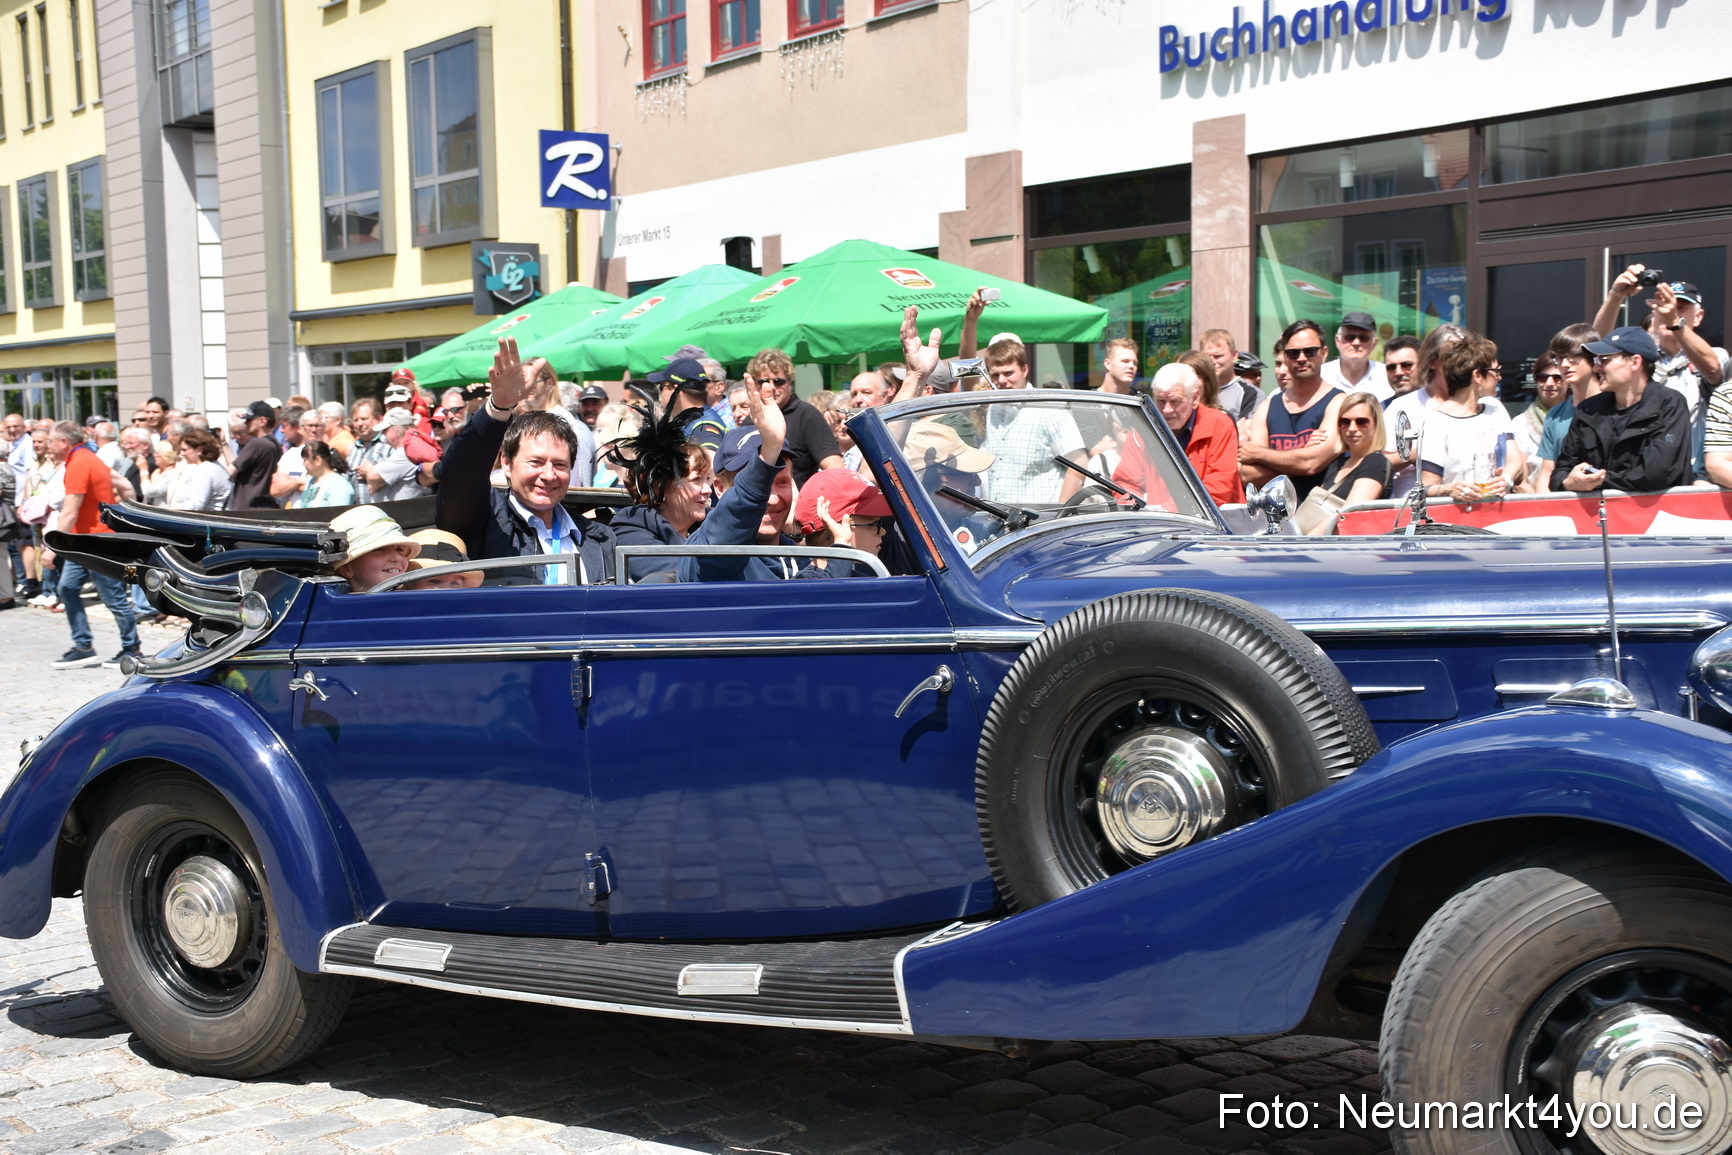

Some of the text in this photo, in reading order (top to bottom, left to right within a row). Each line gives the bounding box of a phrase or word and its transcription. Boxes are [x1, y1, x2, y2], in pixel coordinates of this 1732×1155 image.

[617, 226, 670, 246] Unterer Markt 15
[502, 262, 524, 291] G2
[886, 290, 973, 303] Neumarkte
[1149, 316, 1181, 326] GARTEN
[1154, 327, 1177, 336] BUCH
